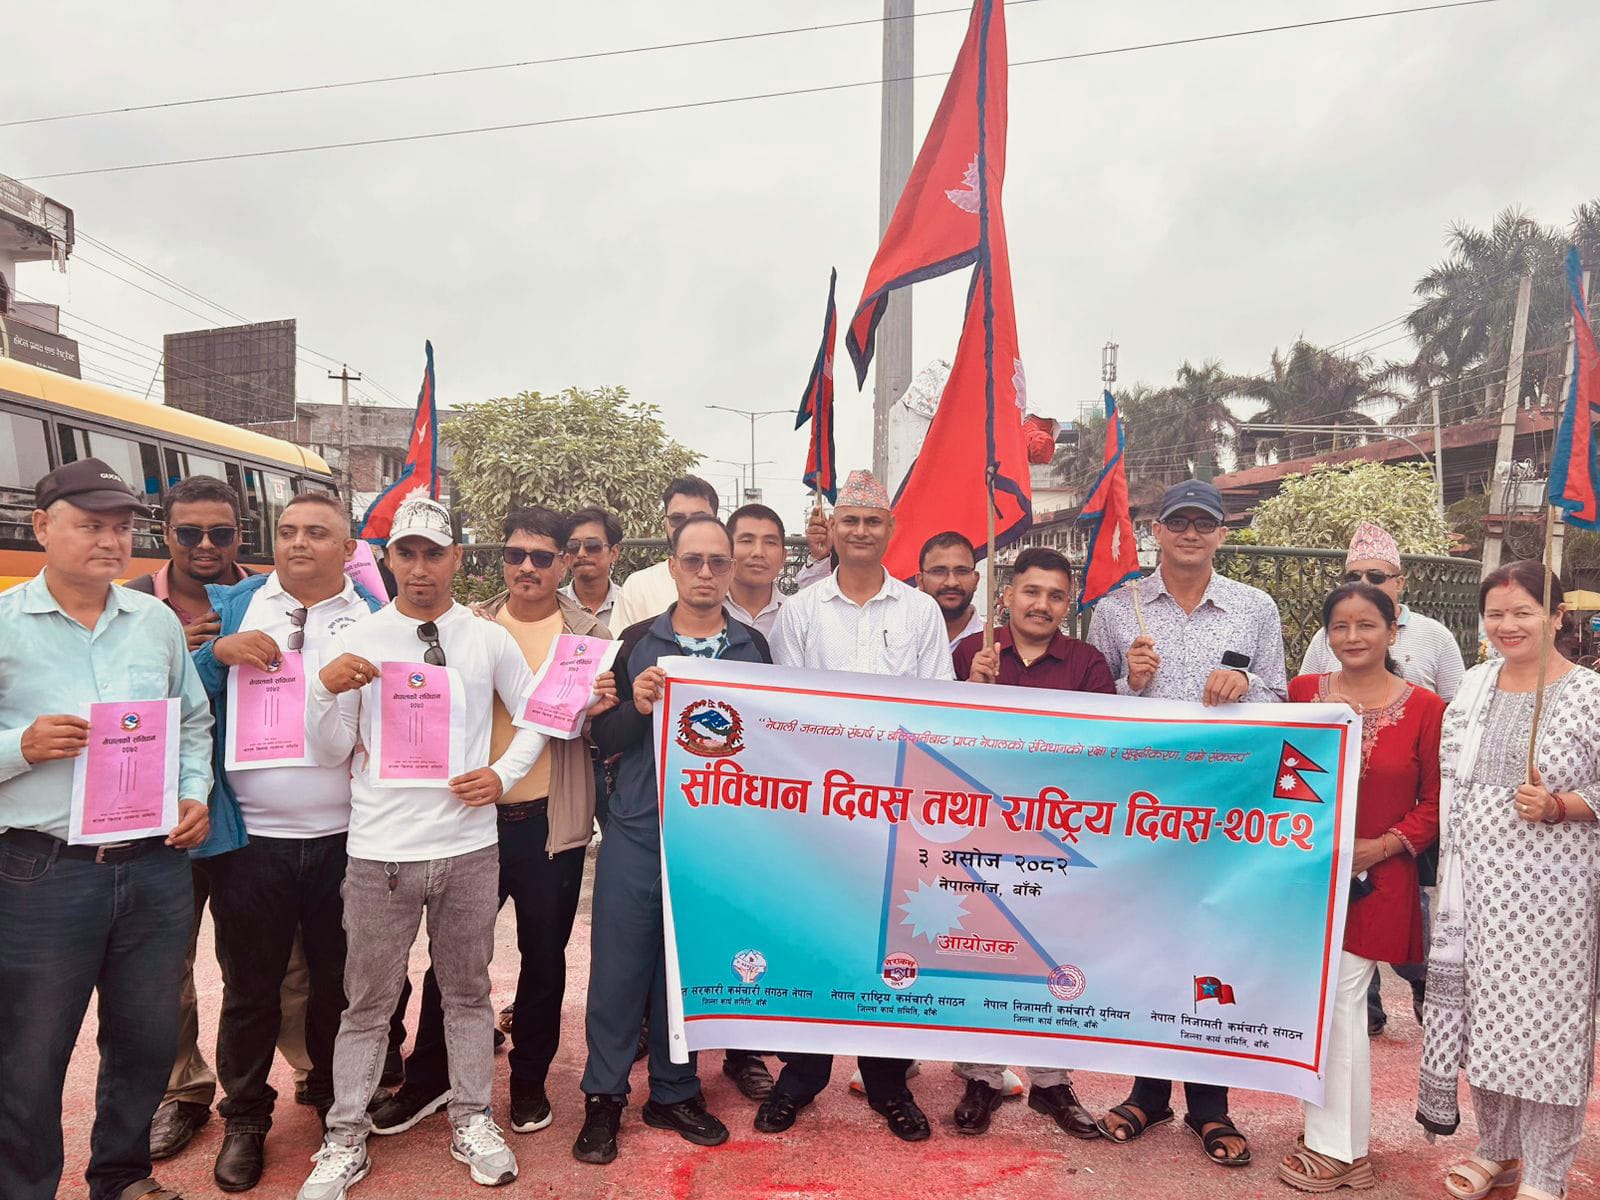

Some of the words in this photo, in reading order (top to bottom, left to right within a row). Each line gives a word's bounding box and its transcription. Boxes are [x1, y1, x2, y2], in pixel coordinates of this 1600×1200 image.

[800, 724, 845, 736] जनताको
[847, 725, 875, 739] संघर्ष
[877, 730, 887, 741] र
[980, 736, 1025, 751] नेपालको
[1028, 739, 1085, 755] संविधानको
[1110, 746, 1120, 758] र
[680, 758, 812, 814] संविधान
[822, 769, 914, 824] दिवस
[922, 789, 993, 829] तथा
[1001, 786, 1117, 844] राष्ट्रिय
[1124, 791, 1315, 850] दिवस-२०८२
[918, 848, 929, 868] ३
[941, 848, 1003, 869] असोज
[1015, 855, 1068, 876] २०८२
[1012, 881, 1043, 897] बाँके
[937, 934, 1019, 954] आयोजक
[692, 983, 724, 996] सरकारी
[728, 984, 761, 997] कर्मचारी
[791, 987, 814, 1000] नेपाल
[831, 989, 855, 1001] नेपाल
[861, 990, 891, 1005] राष्ट्रिय
[896, 992, 934, 1006] कर्मचारी
[984, 998, 1008, 1011] नेपाल
[1013, 999, 1053, 1014] निजामती
[1057, 1004, 1096, 1018] कर्मचारी
[1100, 1008, 1131, 1022] युनियन
[1013, 1013, 1034, 1024] जिल्ला
[1150, 1010, 1176, 1024] नेपाल
[1181, 1013, 1223, 1030] निजामती
[1228, 1021, 1268, 1036] कर्मचारी
[1273, 1026, 1304, 1041] संगठन
[1180, 1030, 1203, 1042] जिल्ला
